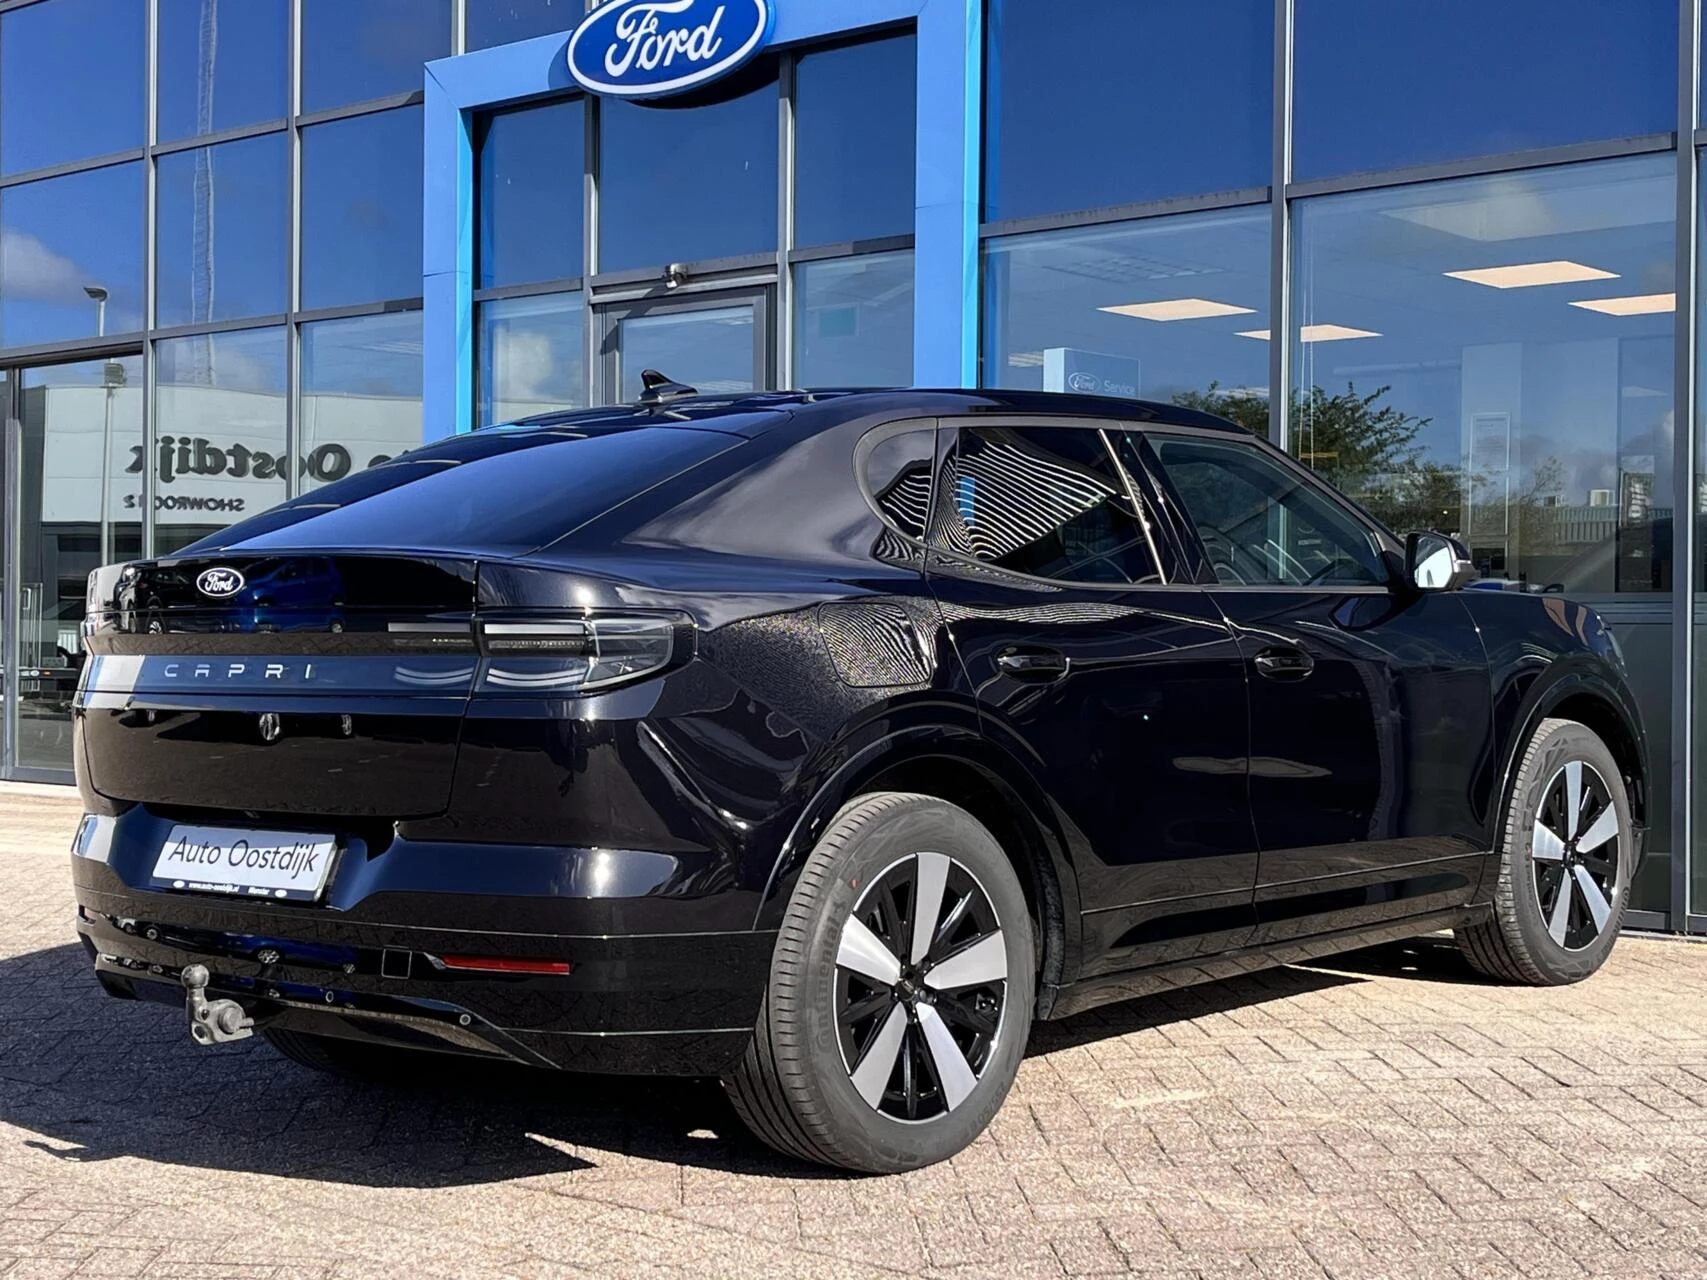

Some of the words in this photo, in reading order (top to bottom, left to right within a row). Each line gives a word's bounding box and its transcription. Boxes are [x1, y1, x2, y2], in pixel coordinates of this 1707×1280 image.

[604, 0, 726, 77] Ford
[1073, 374, 1096, 391] Ford
[1104, 379, 1136, 396] Service
[204, 571, 234, 592] Ford
[164, 663, 312, 680] CAPRI
[168, 835, 221, 865] Auto
[228, 838, 320, 880] Oostdijk
